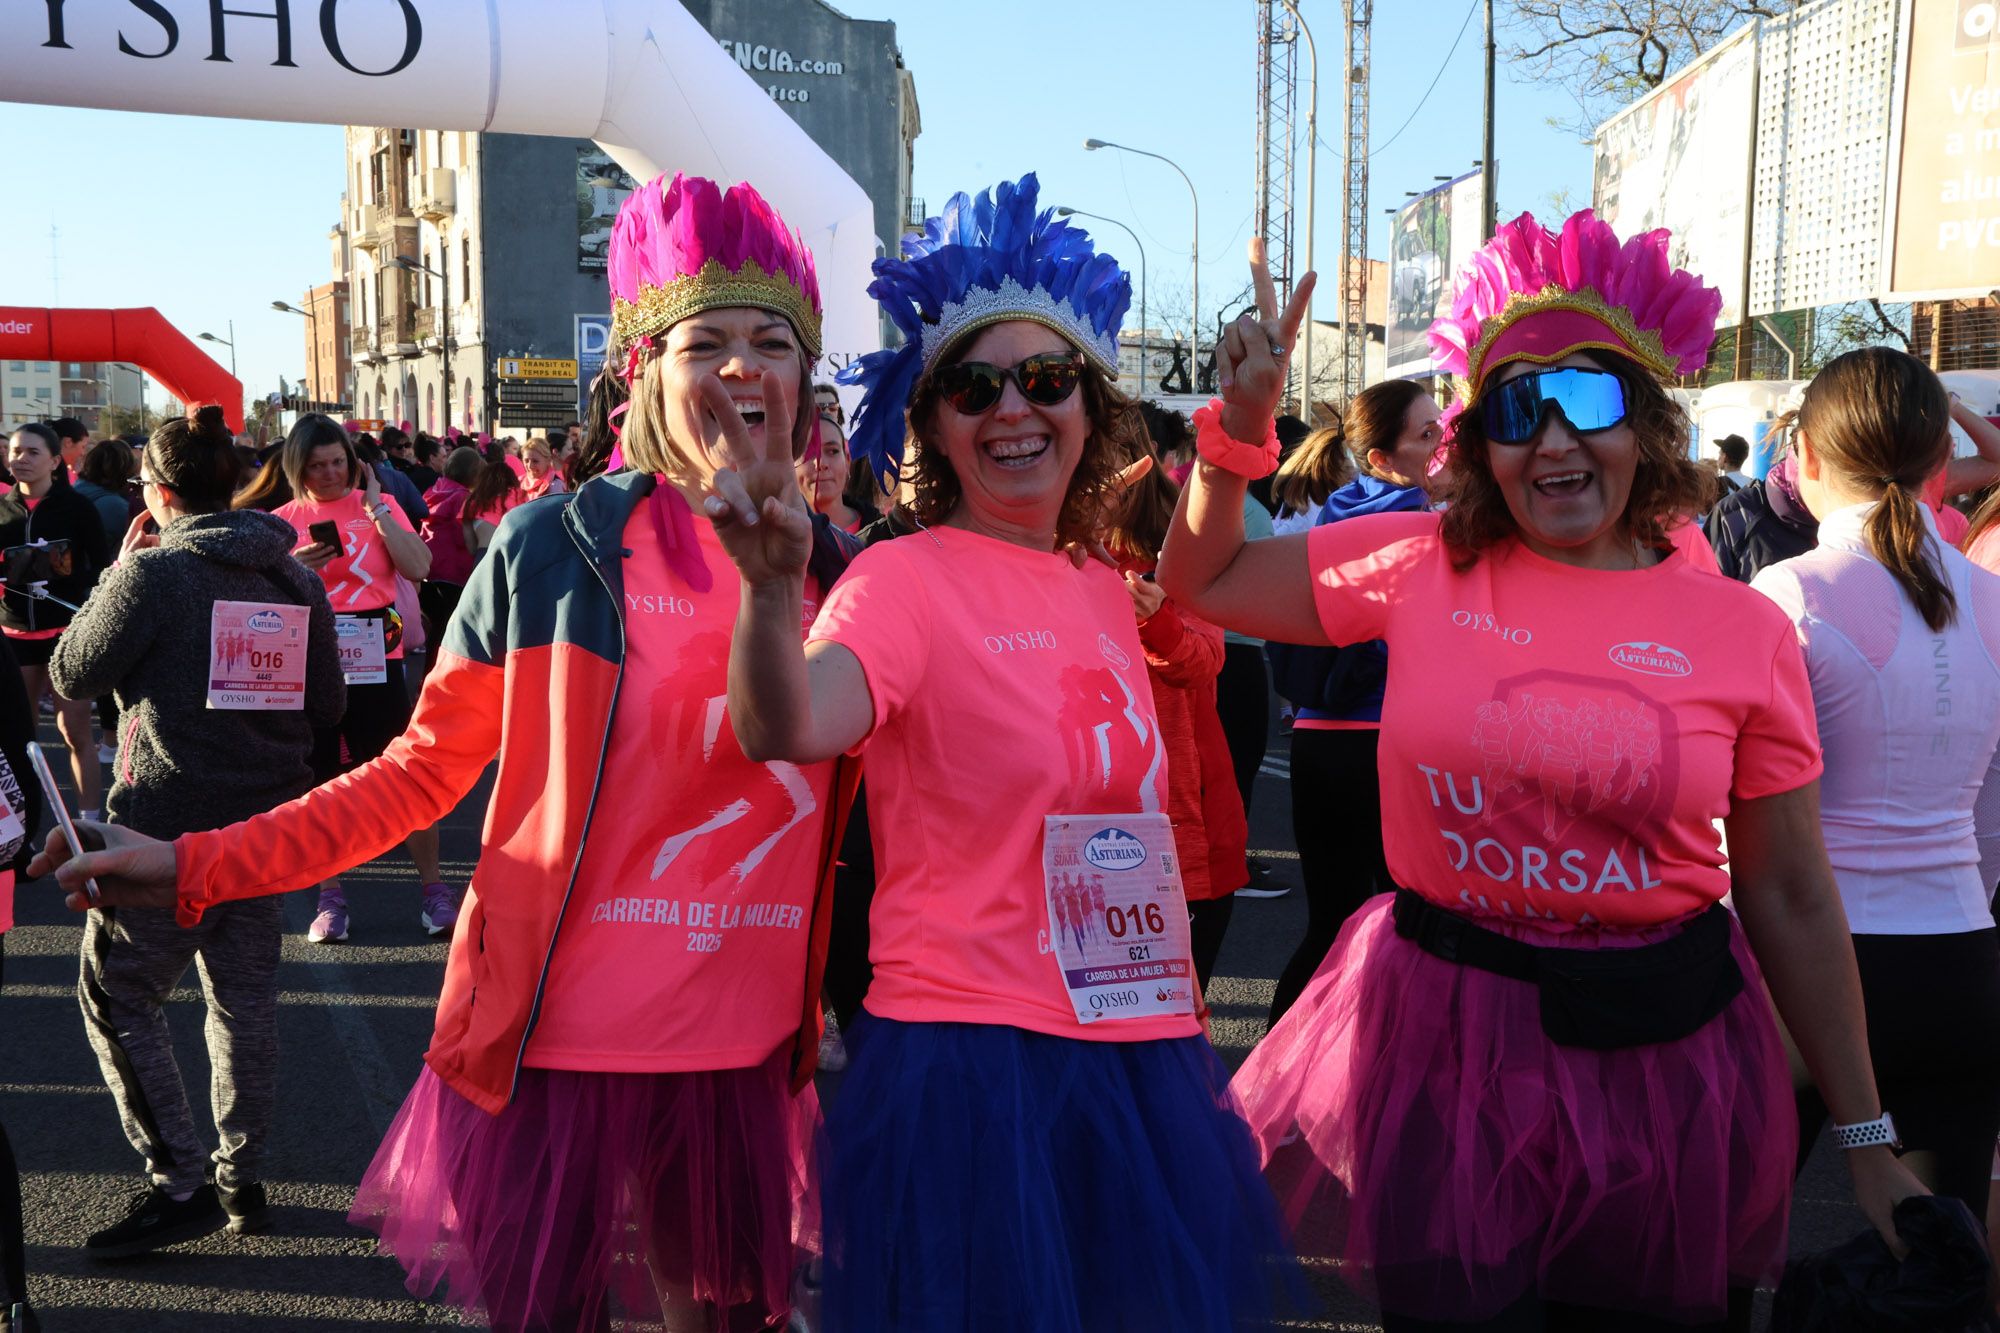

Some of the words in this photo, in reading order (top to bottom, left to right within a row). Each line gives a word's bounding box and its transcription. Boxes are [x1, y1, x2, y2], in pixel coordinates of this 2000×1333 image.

[984, 630, 1057, 653] OYSHO
[250, 651, 283, 669] 016
[1615, 649, 1685, 673] ASTURIANA
[221, 694, 255, 704] OYSHO
[1417, 763, 1484, 815] TU
[1054, 854, 1080, 866] SUMA
[1091, 844, 1143, 861] ASTURIANA
[591, 897, 680, 926] CARRERA
[686, 902, 715, 928] DE
[720, 904, 741, 928] LA
[742, 903, 803, 929] MUJER
[1105, 902, 1165, 938] 016
[686, 932, 723, 952] 2025
[1129, 945, 1150, 961] 621
[1084, 970, 1118, 983] CARRERA
[1118, 969, 1129, 979] DE
[1129, 967, 1140, 978] LA
[1140, 964, 1166, 977] MUJER
[1089, 990, 1139, 1010] OYSHO
